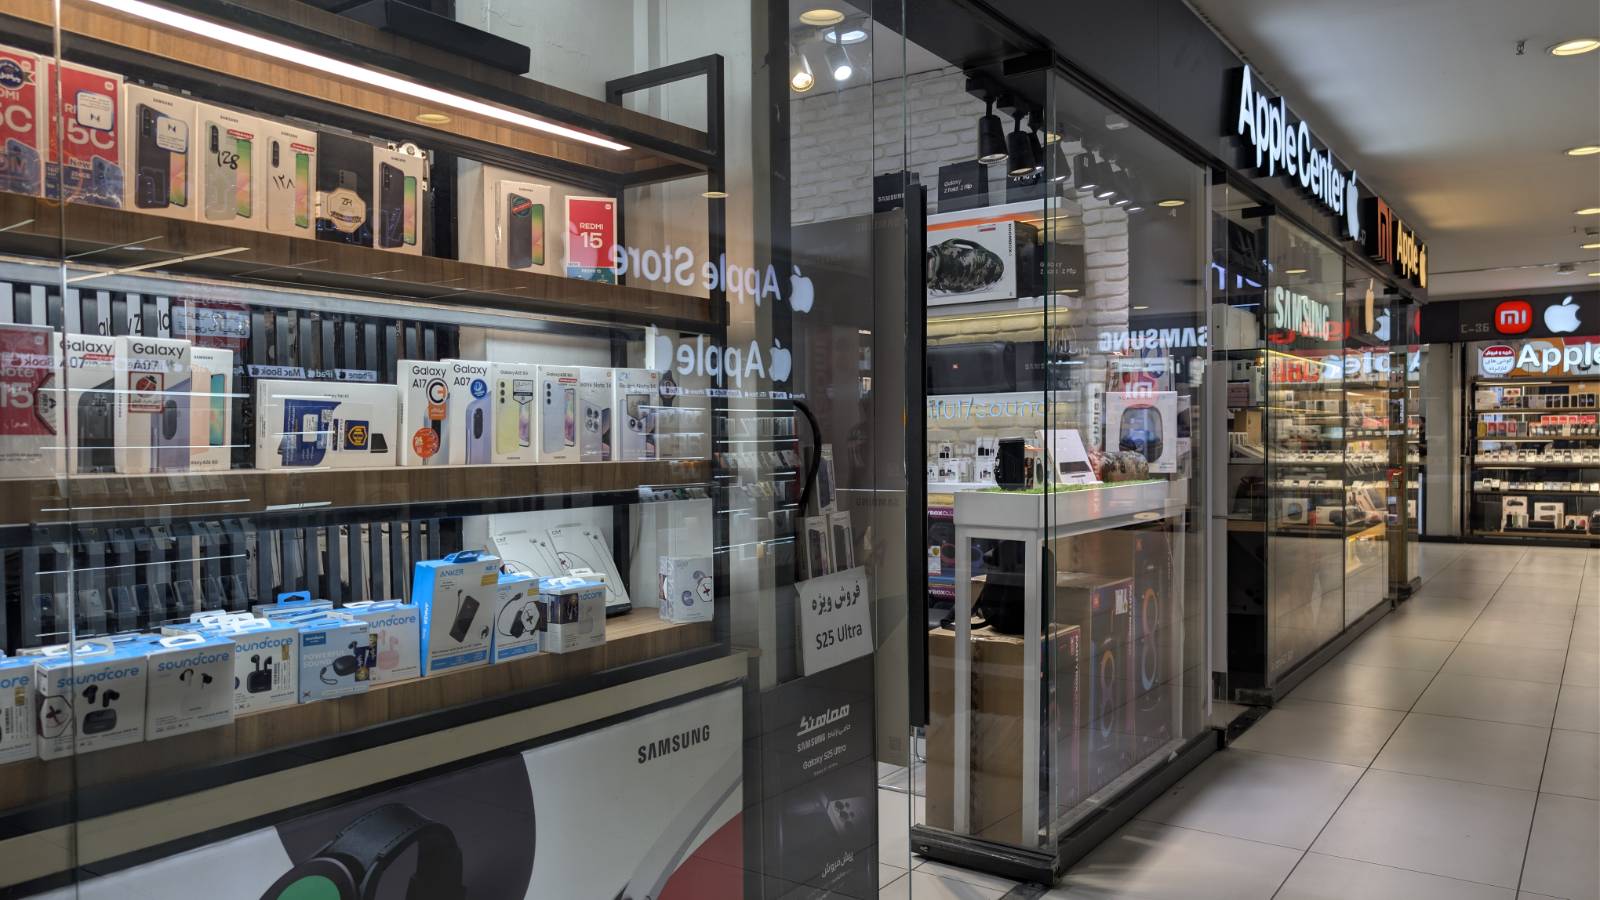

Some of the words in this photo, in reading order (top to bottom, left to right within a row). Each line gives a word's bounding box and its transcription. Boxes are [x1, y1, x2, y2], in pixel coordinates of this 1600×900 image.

[1238, 64, 1296, 177] Apple
[1298, 120, 1346, 216] Center
[217, 150, 240, 170] 128
[579, 222, 604, 231] REDMI
[580, 231, 603, 249] 15
[1397, 219, 1419, 280] Apple
[1274, 286, 1330, 341] SAMSUNG
[59, 340, 113, 356] Galaxy
[132, 342, 184, 359] Galaxy
[412, 365, 447, 378] Galaxy
[453, 363, 488, 376] Galaxy
[412, 378, 427, 389] A17
[453, 376, 471, 386] A07
[0, 380, 35, 410] 15
[440, 568, 464, 577] ANKER
[811, 592, 832, 615] ویژه
[834, 580, 861, 610] فروش
[367, 614, 417, 630] undcore
[235, 636, 294, 653] oundcore
[816, 629, 835, 650] S25
[837, 623, 863, 642] Ultra
[158, 651, 230, 672] soundcore
[57, 665, 140, 689] soundcore
[637, 724, 711, 764] SAMSUNG
[797, 732, 826, 753] SAMSUNG
[802, 754, 824, 770] Galaxy
